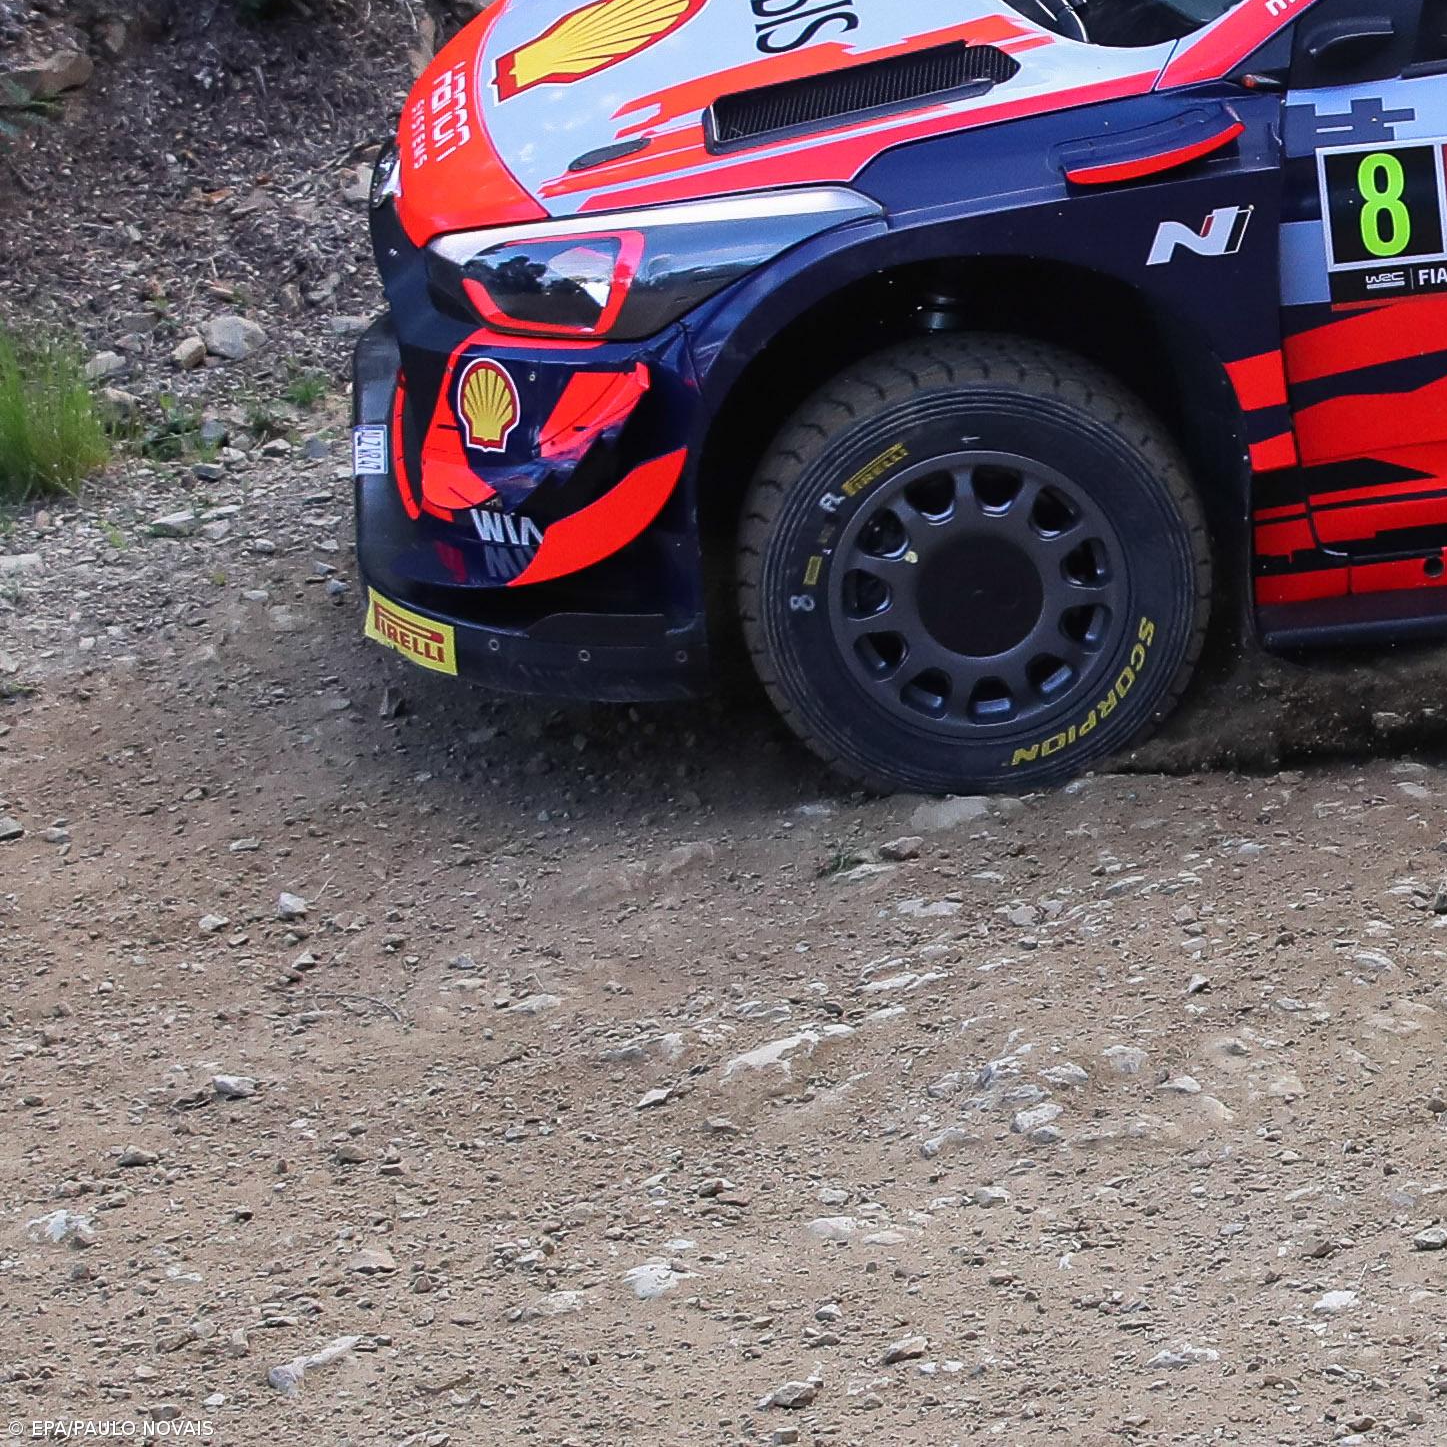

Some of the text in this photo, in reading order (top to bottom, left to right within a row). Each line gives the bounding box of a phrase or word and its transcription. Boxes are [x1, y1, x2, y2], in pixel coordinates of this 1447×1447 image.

[1357, 152, 1411, 256] 8
[373, 600, 446, 663] PIRELLI
[1011, 616, 1156, 766] SCORPION
